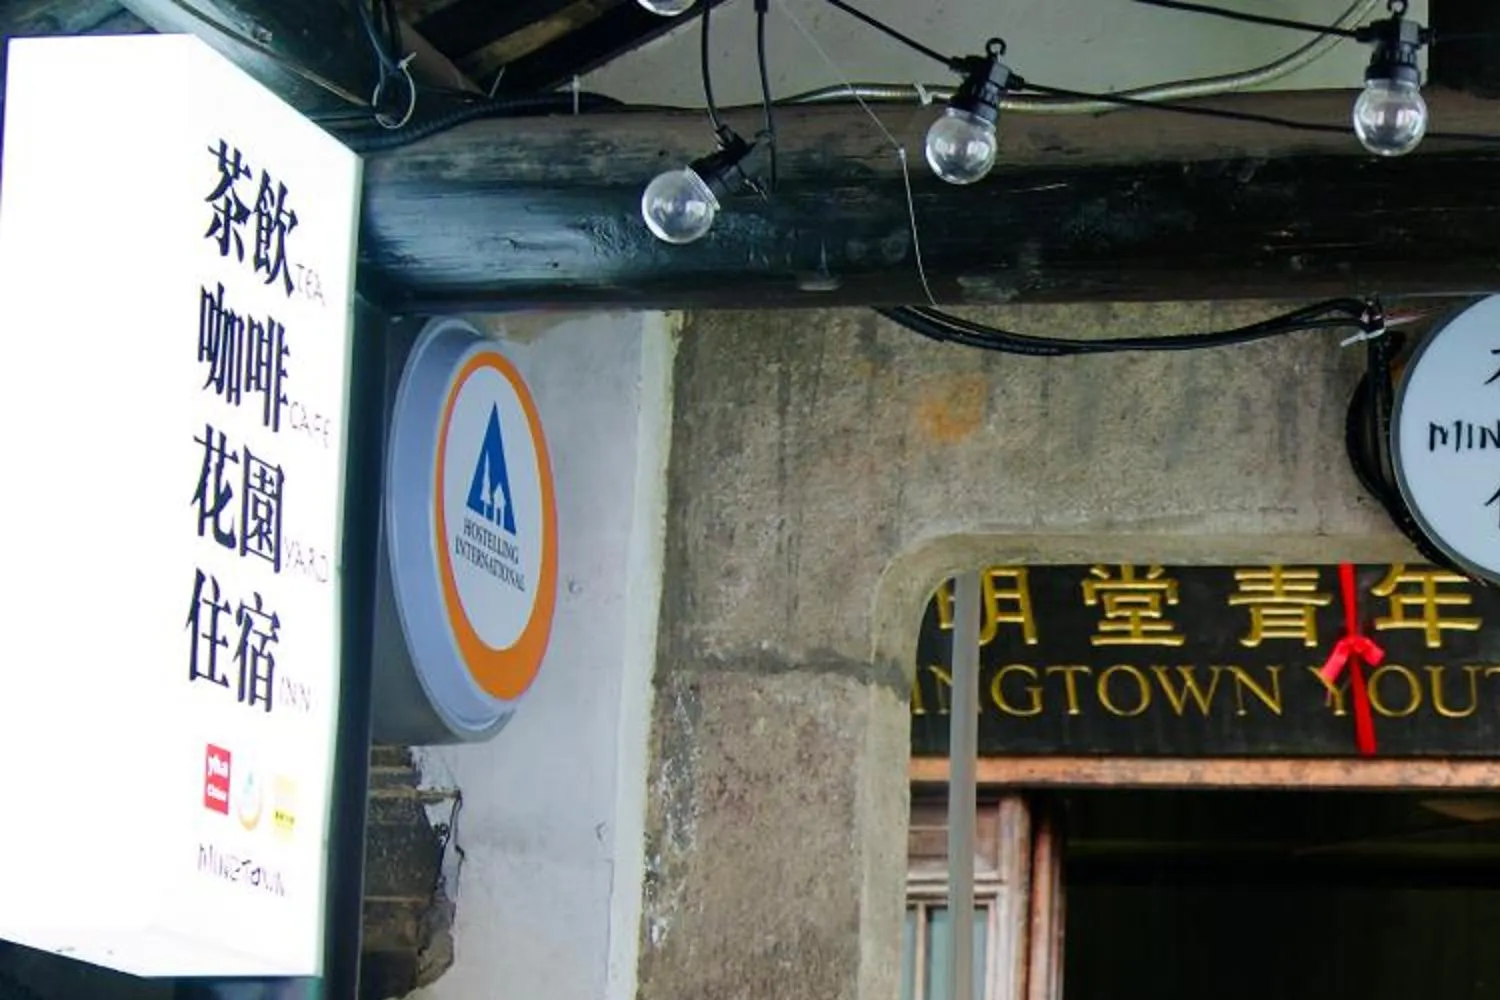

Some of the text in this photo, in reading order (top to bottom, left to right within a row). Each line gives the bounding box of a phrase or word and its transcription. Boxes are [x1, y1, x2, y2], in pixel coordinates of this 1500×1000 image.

[204, 138, 299, 297] 茶飲
[198, 281, 290, 432] 咖啡
[190, 422, 285, 573] 花園
[455, 533, 525, 592] INTERNATIONAL
[463, 517, 519, 565] HOSTELLING
[184, 567, 281, 712] 住宿
